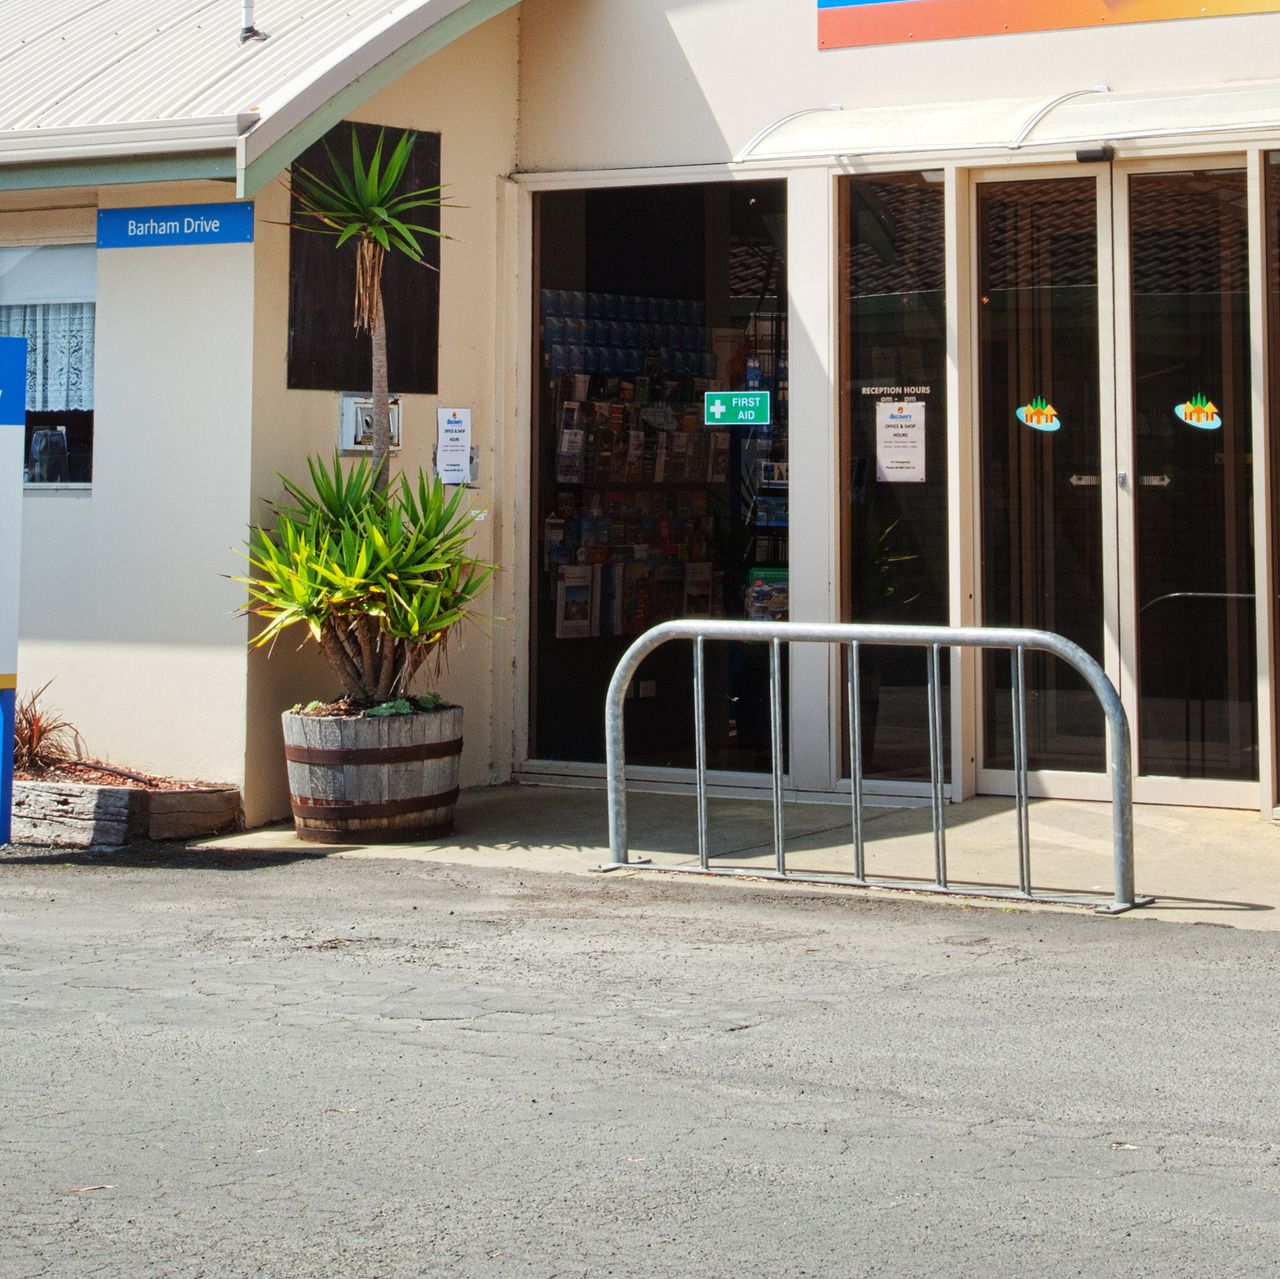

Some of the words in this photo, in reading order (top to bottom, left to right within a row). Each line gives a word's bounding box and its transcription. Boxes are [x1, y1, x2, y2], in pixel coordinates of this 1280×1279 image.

[128, 218, 180, 236] Barham
[184, 216, 220, 233] Drive
[861, 386, 902, 394] RECEPTION
[904, 386, 931, 394] HOURS
[732, 397, 761, 407] FIRST
[737, 410, 755, 420] AID
